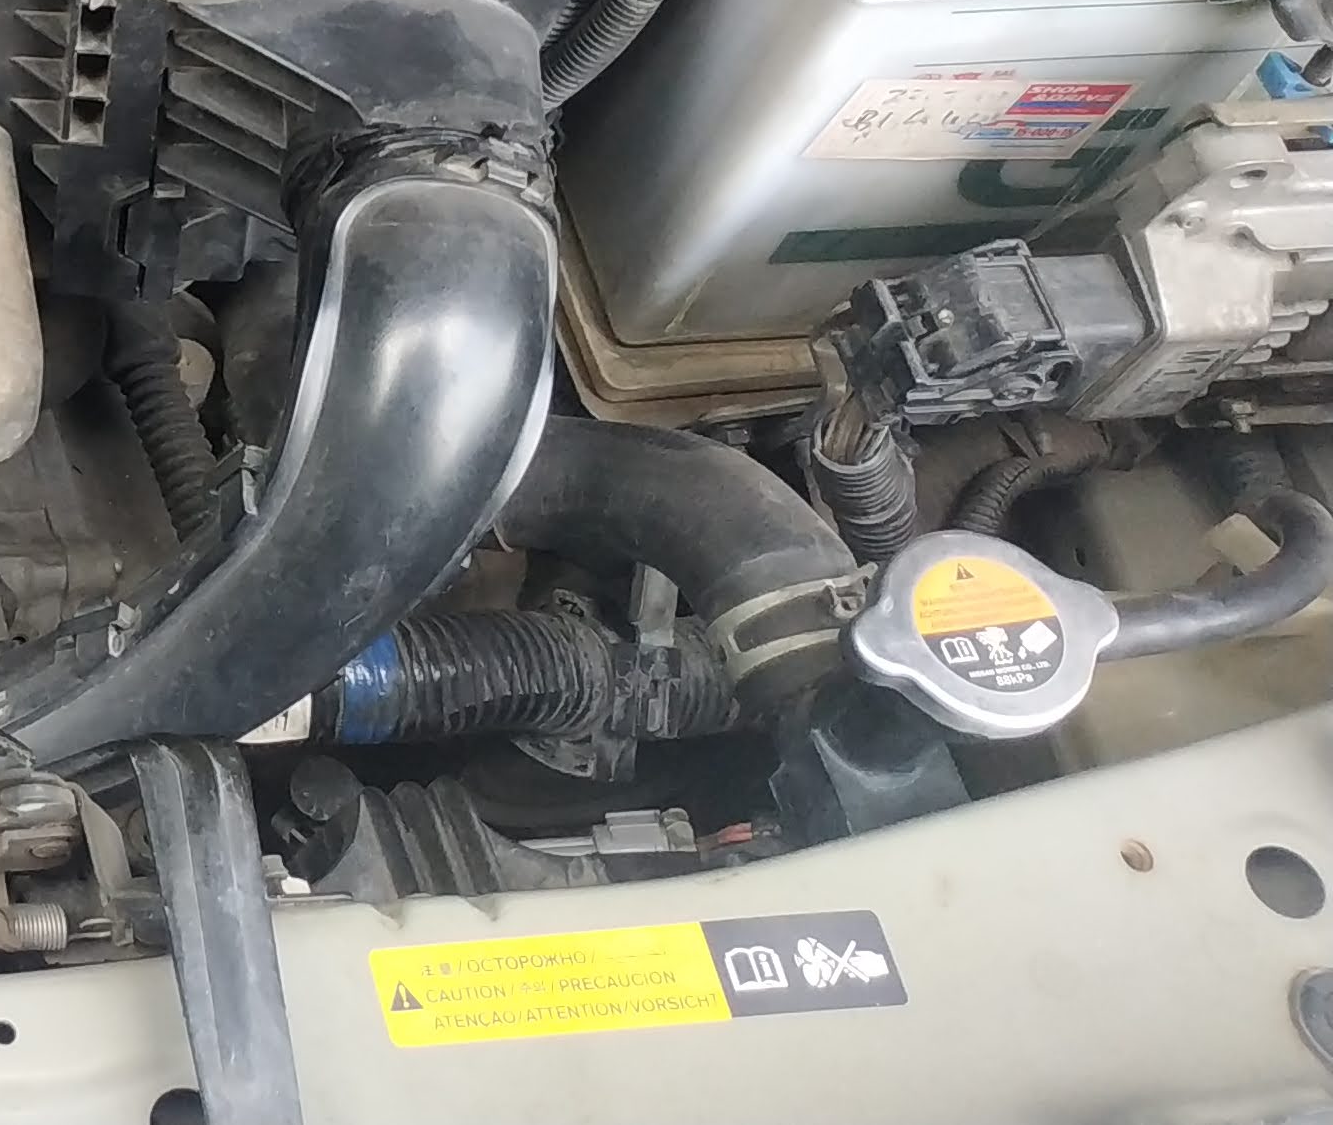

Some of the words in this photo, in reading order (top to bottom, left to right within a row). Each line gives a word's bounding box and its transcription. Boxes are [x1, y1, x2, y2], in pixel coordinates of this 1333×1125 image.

[1027, 85, 1090, 94] SHOP
[995, 672, 1034, 687] 88kPa
[426, 985, 507, 1004] CAUTION
